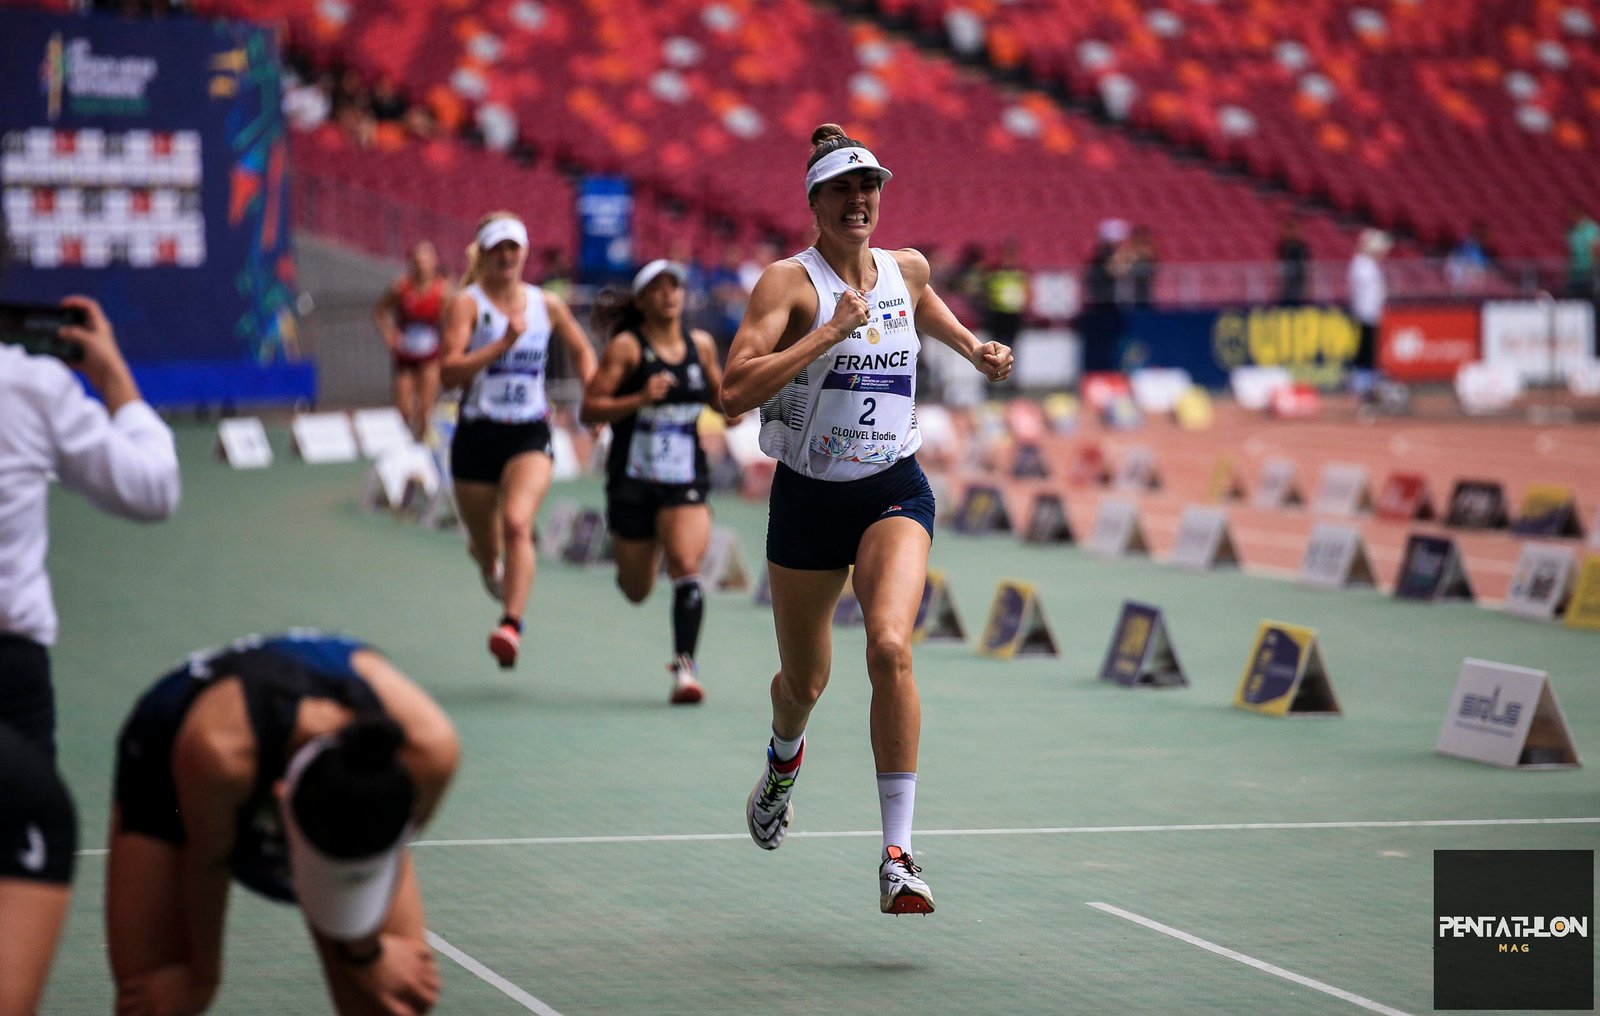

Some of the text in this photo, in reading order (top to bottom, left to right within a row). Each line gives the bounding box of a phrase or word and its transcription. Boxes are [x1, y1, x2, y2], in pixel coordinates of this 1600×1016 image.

[833, 350, 909, 371] FRANCE
[858, 397, 876, 426] 2
[830, 426, 897, 441] CLOUVEL Elodie
